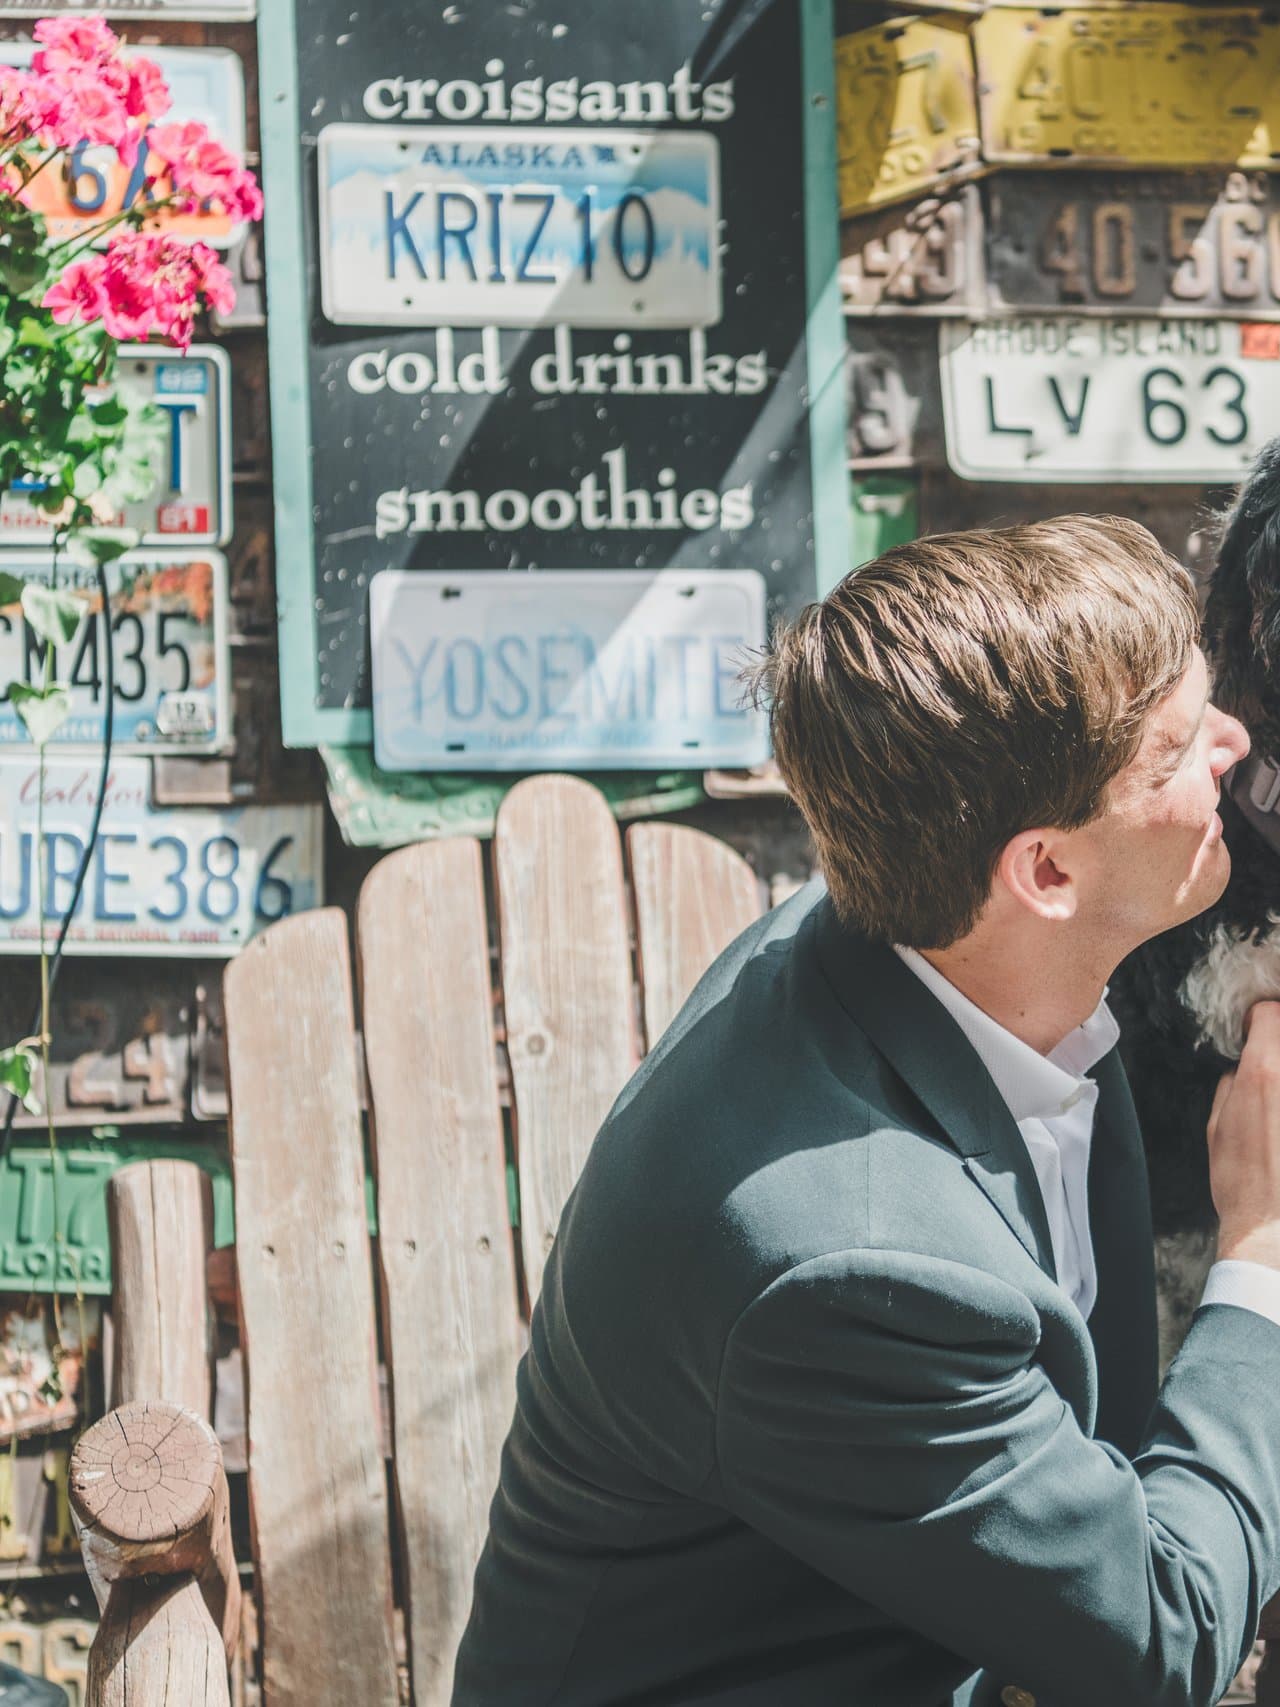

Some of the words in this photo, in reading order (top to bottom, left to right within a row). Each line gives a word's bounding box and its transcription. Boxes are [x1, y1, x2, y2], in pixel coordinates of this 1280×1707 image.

[363, 57, 736, 123] croissants
[421, 143, 584, 168] ALASKA
[384, 189, 655, 284] KRIZ10
[347, 327, 508, 395] cold
[530, 327, 770, 395] drinks
[973, 319, 1081, 356] RHODE
[1098, 319, 1221, 356] ISLAND
[1142, 366, 1250, 446] 63
[374, 447, 756, 538] smoothies
[389, 633, 749, 723] YOSEMITE
